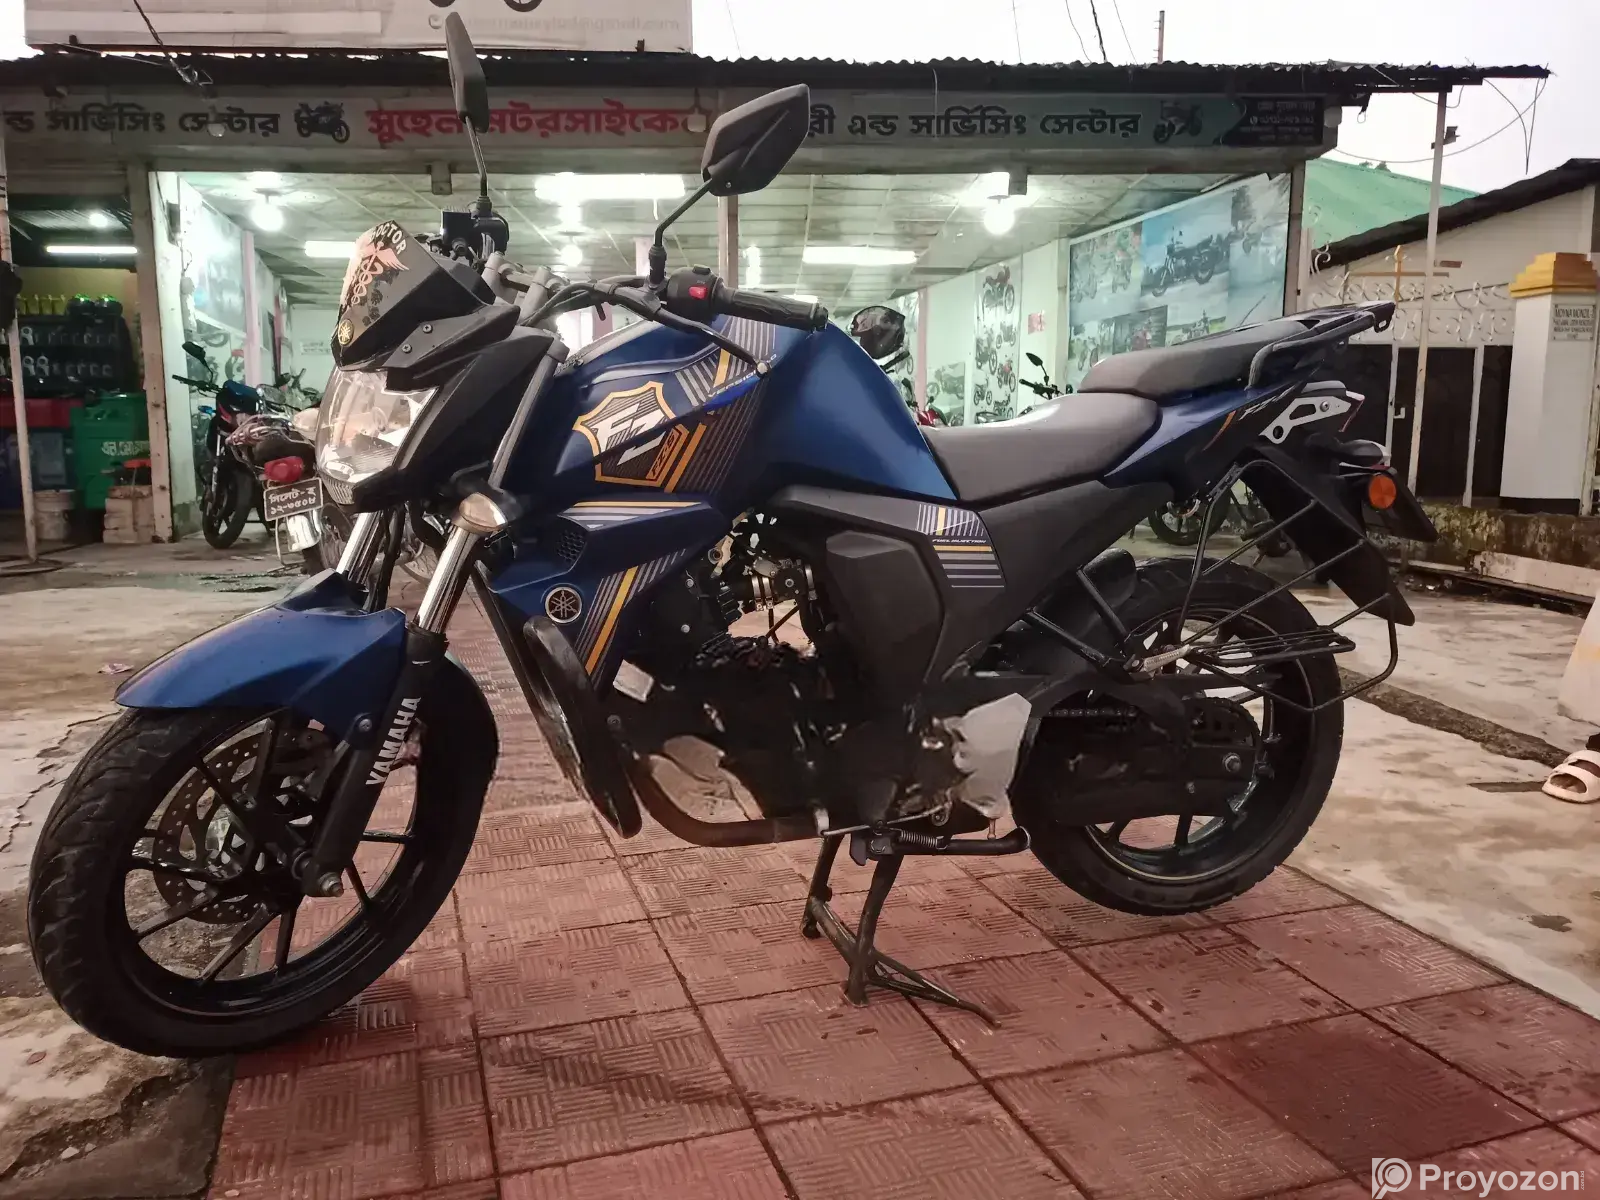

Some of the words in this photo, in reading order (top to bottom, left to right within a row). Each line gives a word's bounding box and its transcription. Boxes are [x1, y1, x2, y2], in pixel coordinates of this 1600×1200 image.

[45, 102, 166, 133] সার্ভিসিং
[179, 106, 281, 138] সেটার
[808, 103, 837, 138] রী
[847, 113, 899, 136] এন্ড
[908, 104, 1027, 137] সার্ভিসিং
[1039, 108, 1142, 138] সেন্টার
[707, 369, 757, 398] VERSIO
[365, 697, 421, 785] YAMAHA
